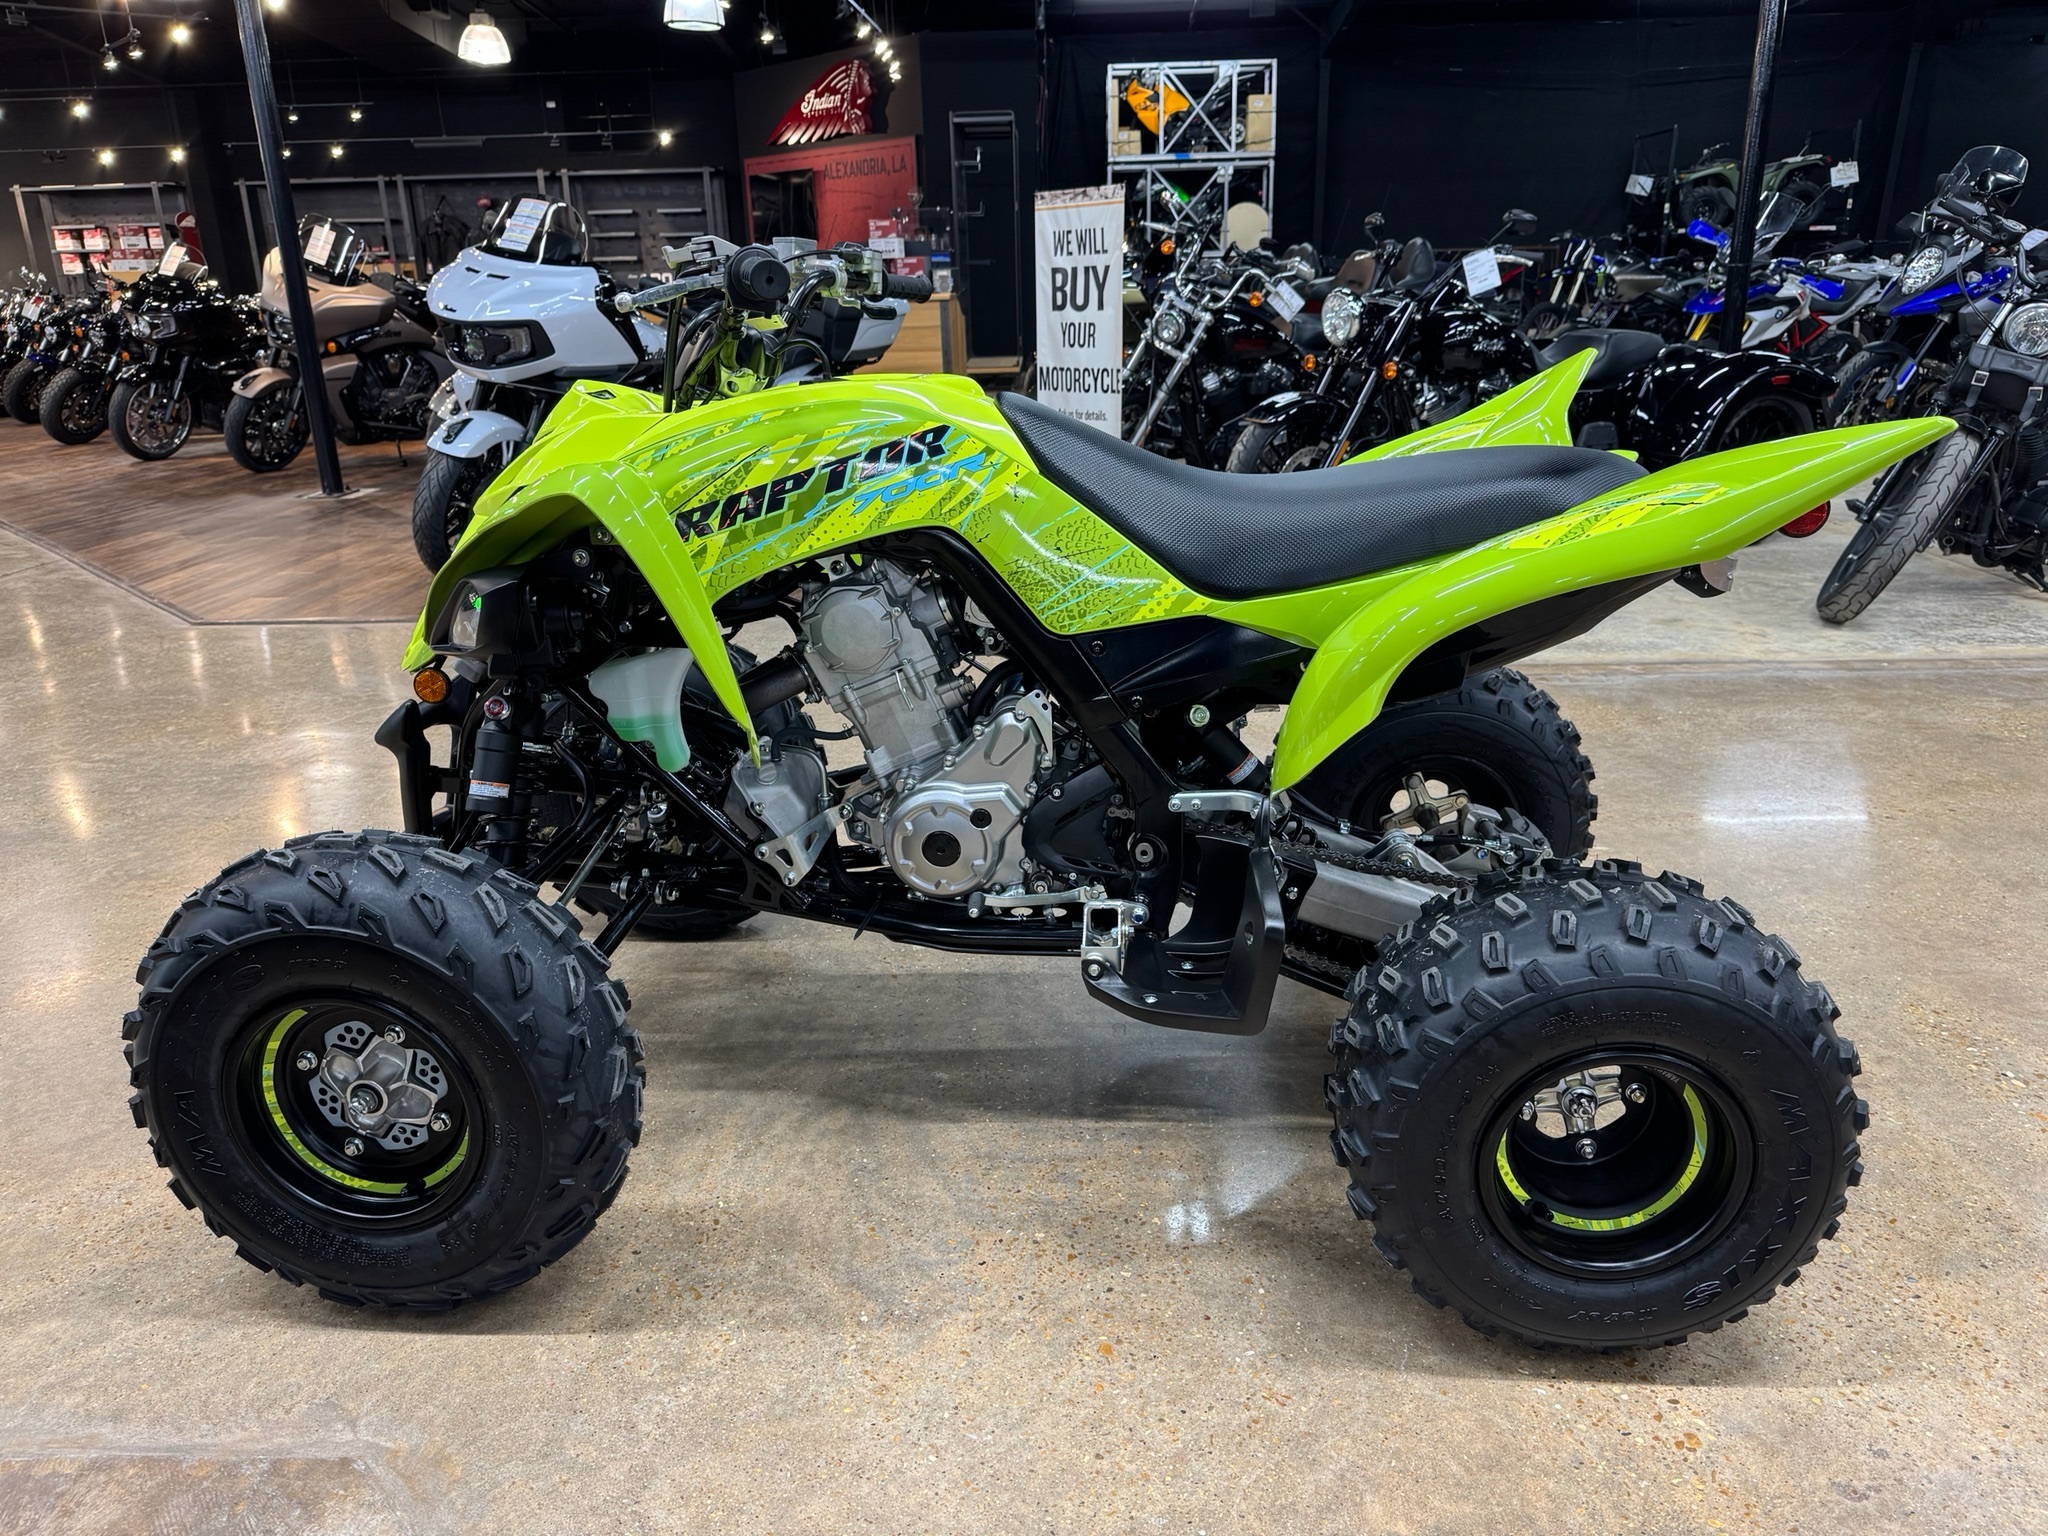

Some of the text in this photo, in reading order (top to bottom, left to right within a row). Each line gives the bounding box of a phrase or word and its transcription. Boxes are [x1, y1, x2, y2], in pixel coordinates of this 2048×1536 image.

[801, 89, 841, 113] Indian
[824, 154, 907, 180] ALEXANDRIA, LA
[1053, 227, 1108, 257] WE WILL
[1051, 264, 1111, 312] BUY
[1060, 321, 1096, 349] YOUR
[1039, 366, 1121, 395] MOTORCYCLE
[674, 424, 954, 544] RAPTOR
[849, 451, 989, 517] 700R
[1683, 1089, 1812, 1311] MAXXIS
